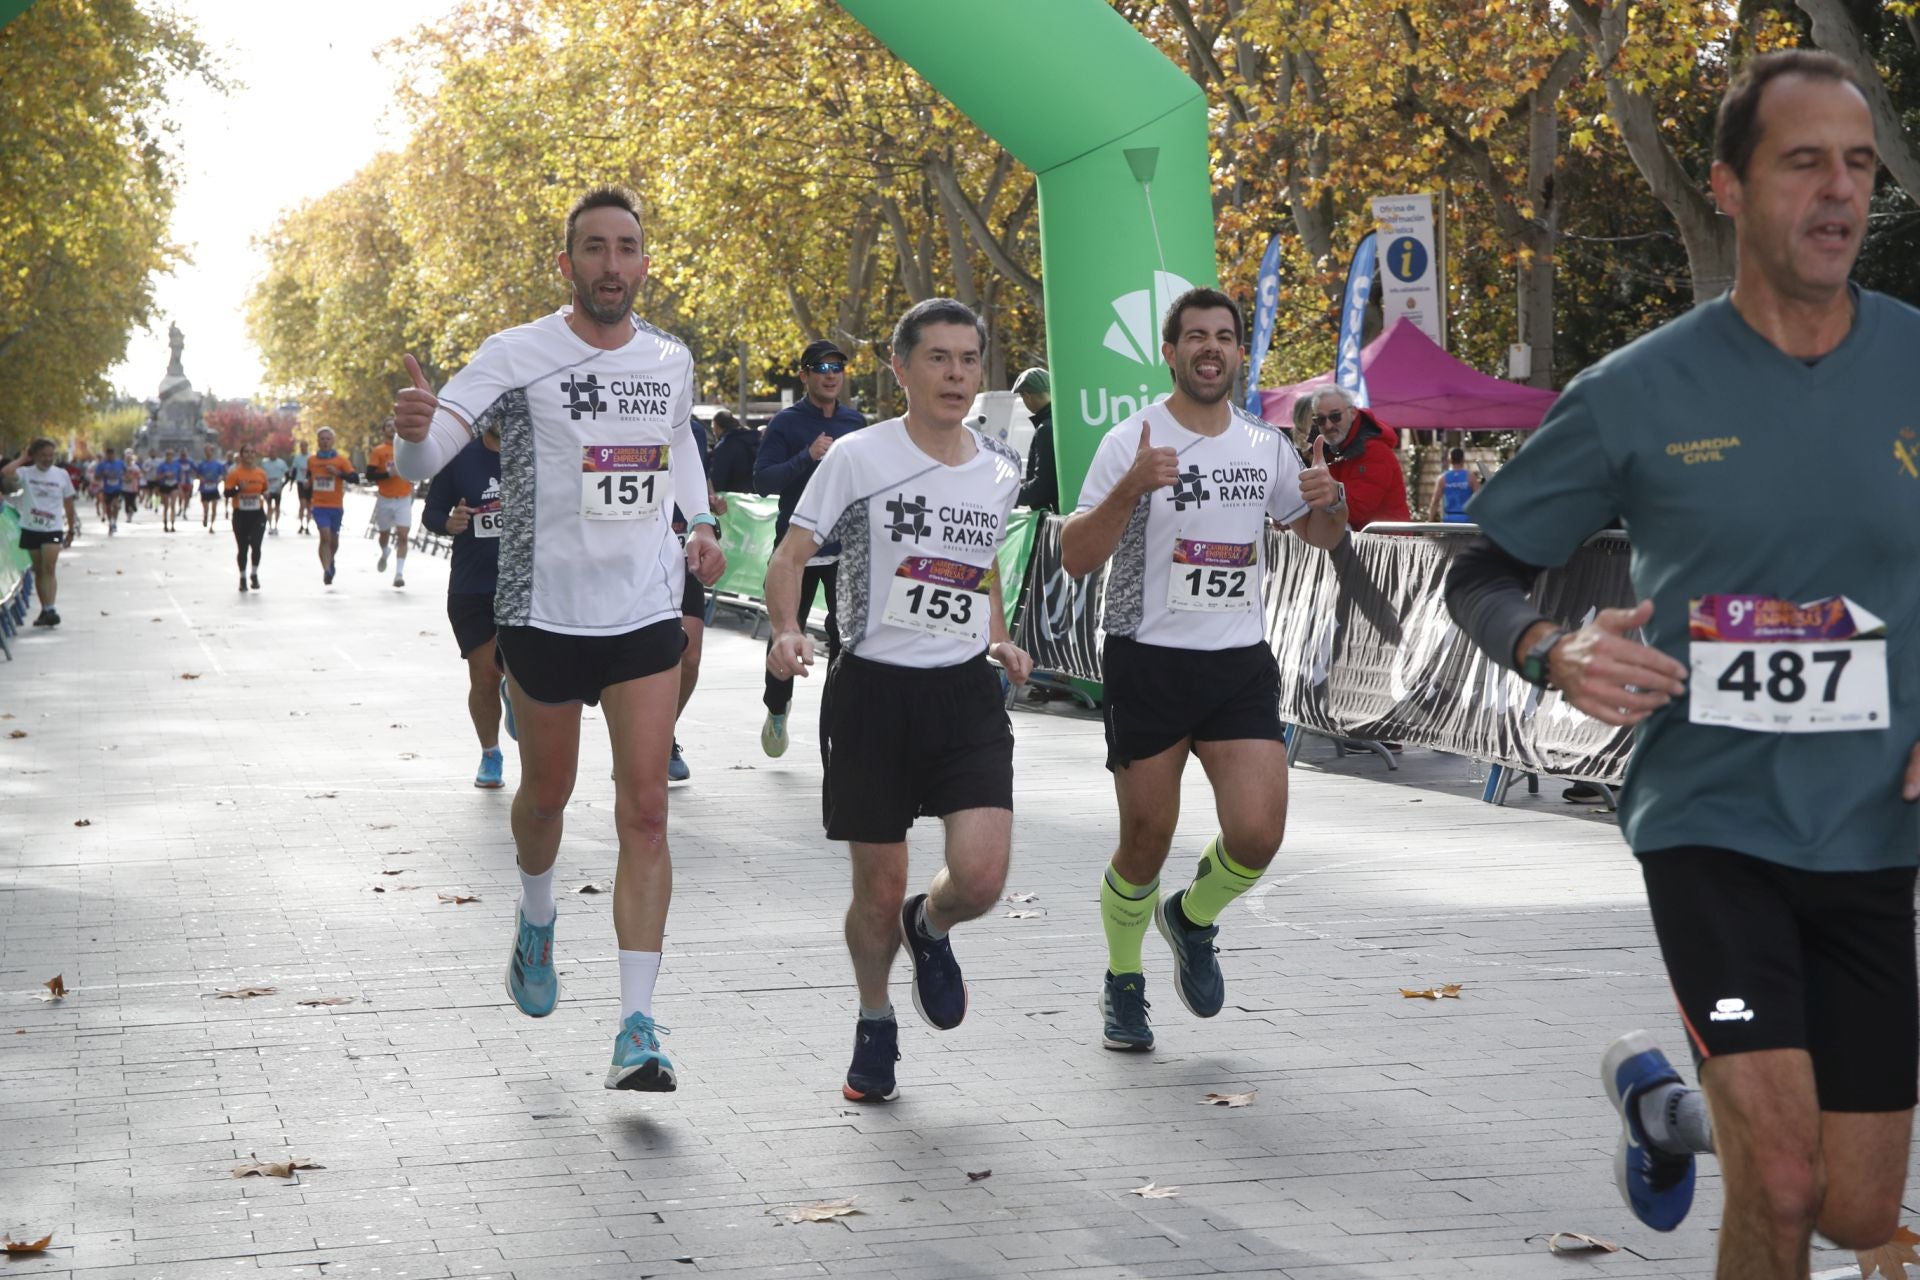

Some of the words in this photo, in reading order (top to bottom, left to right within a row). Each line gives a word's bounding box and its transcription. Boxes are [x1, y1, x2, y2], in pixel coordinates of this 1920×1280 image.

[610, 381, 671, 398] CUATRO
[618, 398, 667, 416] RAYAS
[1665, 436, 1741, 455] GUARDIA
[1683, 450, 1724, 465] CIVIL
[1212, 468, 1268, 484] CUATRO
[481, 491, 501, 501] MIC
[597, 475, 655, 505] 151
[1219, 485, 1265, 501] RAYAS
[481, 514, 504, 530] 66
[939, 506, 999, 530] CUATRO
[942, 525, 994, 547] RAYAS
[1185, 568, 1247, 598] 152
[906, 585, 973, 625] 153
[1717, 649, 1852, 704] 487
